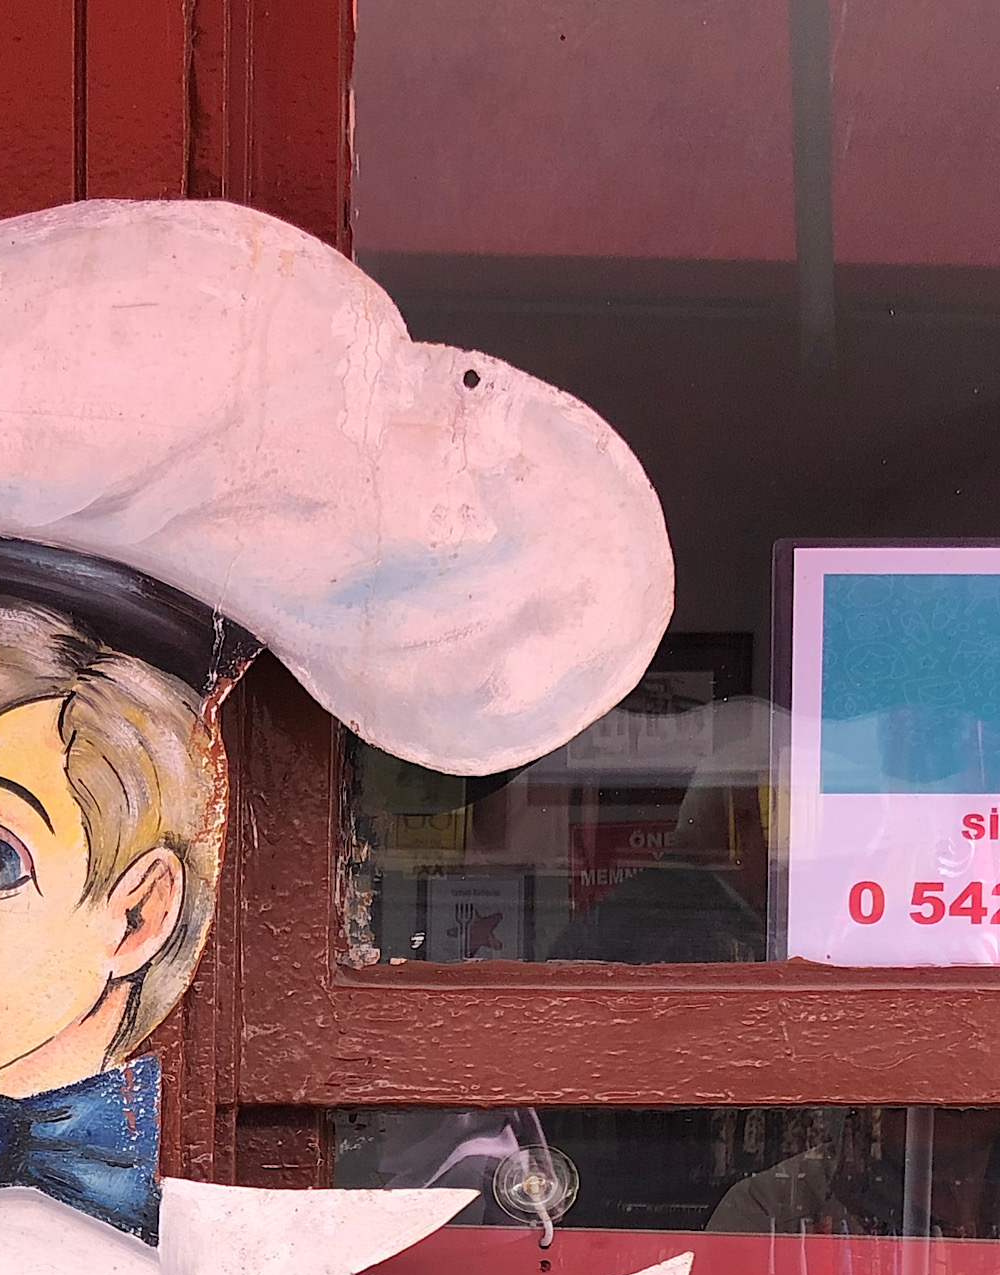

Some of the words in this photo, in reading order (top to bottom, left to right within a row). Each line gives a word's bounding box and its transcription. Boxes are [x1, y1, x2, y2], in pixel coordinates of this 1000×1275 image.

[628, 829, 677, 849] ÖNE
[848, 881, 885, 925] 0
[909, 881, 1000, 925] 54
